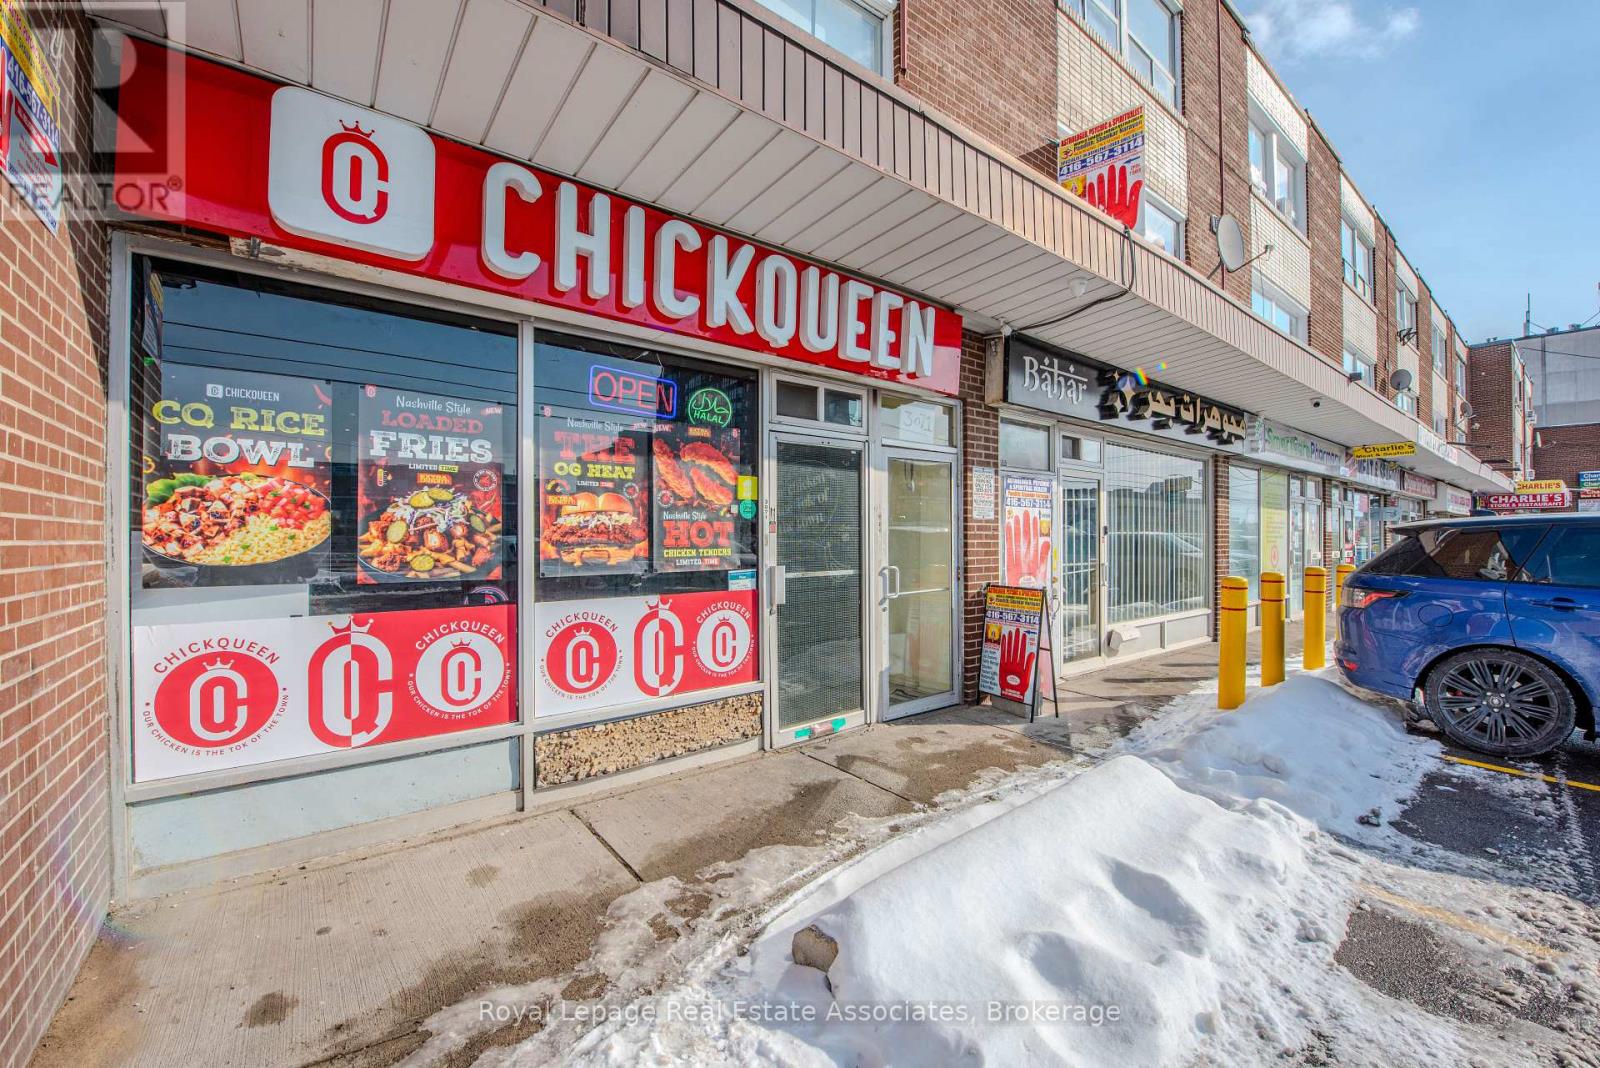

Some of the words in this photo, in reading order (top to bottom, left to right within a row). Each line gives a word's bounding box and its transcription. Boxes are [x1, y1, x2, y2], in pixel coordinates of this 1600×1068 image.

[1061, 137, 1143, 175] 416-567-3114
[481, 161, 936, 379] CHICKQUEEN
[225, 387, 280, 402] CHICKQUEEN
[396, 394, 443, 411] Nashville
[446, 401, 471, 416] Style
[593, 372, 674, 413] OPEN
[152, 400, 215, 430] CQ
[230, 406, 326, 436] RICE
[381, 410, 484, 434] LOADED
[567, 417, 602, 430] Nashville
[694, 409, 724, 425] HALAL
[166, 433, 315, 468] BOWL
[370, 430, 493, 464] FRIES
[554, 431, 636, 465] THE
[1363, 443, 1415, 454] Charlie's
[408, 462, 438, 471] LIMITED
[554, 461, 582, 476] OG
[587, 463, 635, 479] HEAT
[1490, 494, 1562, 504] CHARLIE'S
[663, 520, 735, 548] HOT
[663, 548, 696, 558] CHICKEN
[699, 548, 732, 556] TENDERS
[545, 611, 619, 639] CHICKQUEEN
[696, 601, 751, 625] CHICKQUEEN
[986, 610, 1040, 624] 416-567-3114
[415, 620, 505, 651] CHICKQUEEN
[154, 637, 281, 674] CHICKQUEEN
[407, 680, 416, 695] OUR
[413, 696, 440, 717] CHICKEN
[483, 701, 492, 710] OF
[492, 690, 504, 702] THE
[142, 711, 154, 728] OUR
[151, 729, 188, 754] CHICKEN
[251, 734, 262, 743] OF
[264, 720, 279, 733] THE
[276, 695, 289, 720] TOWN
